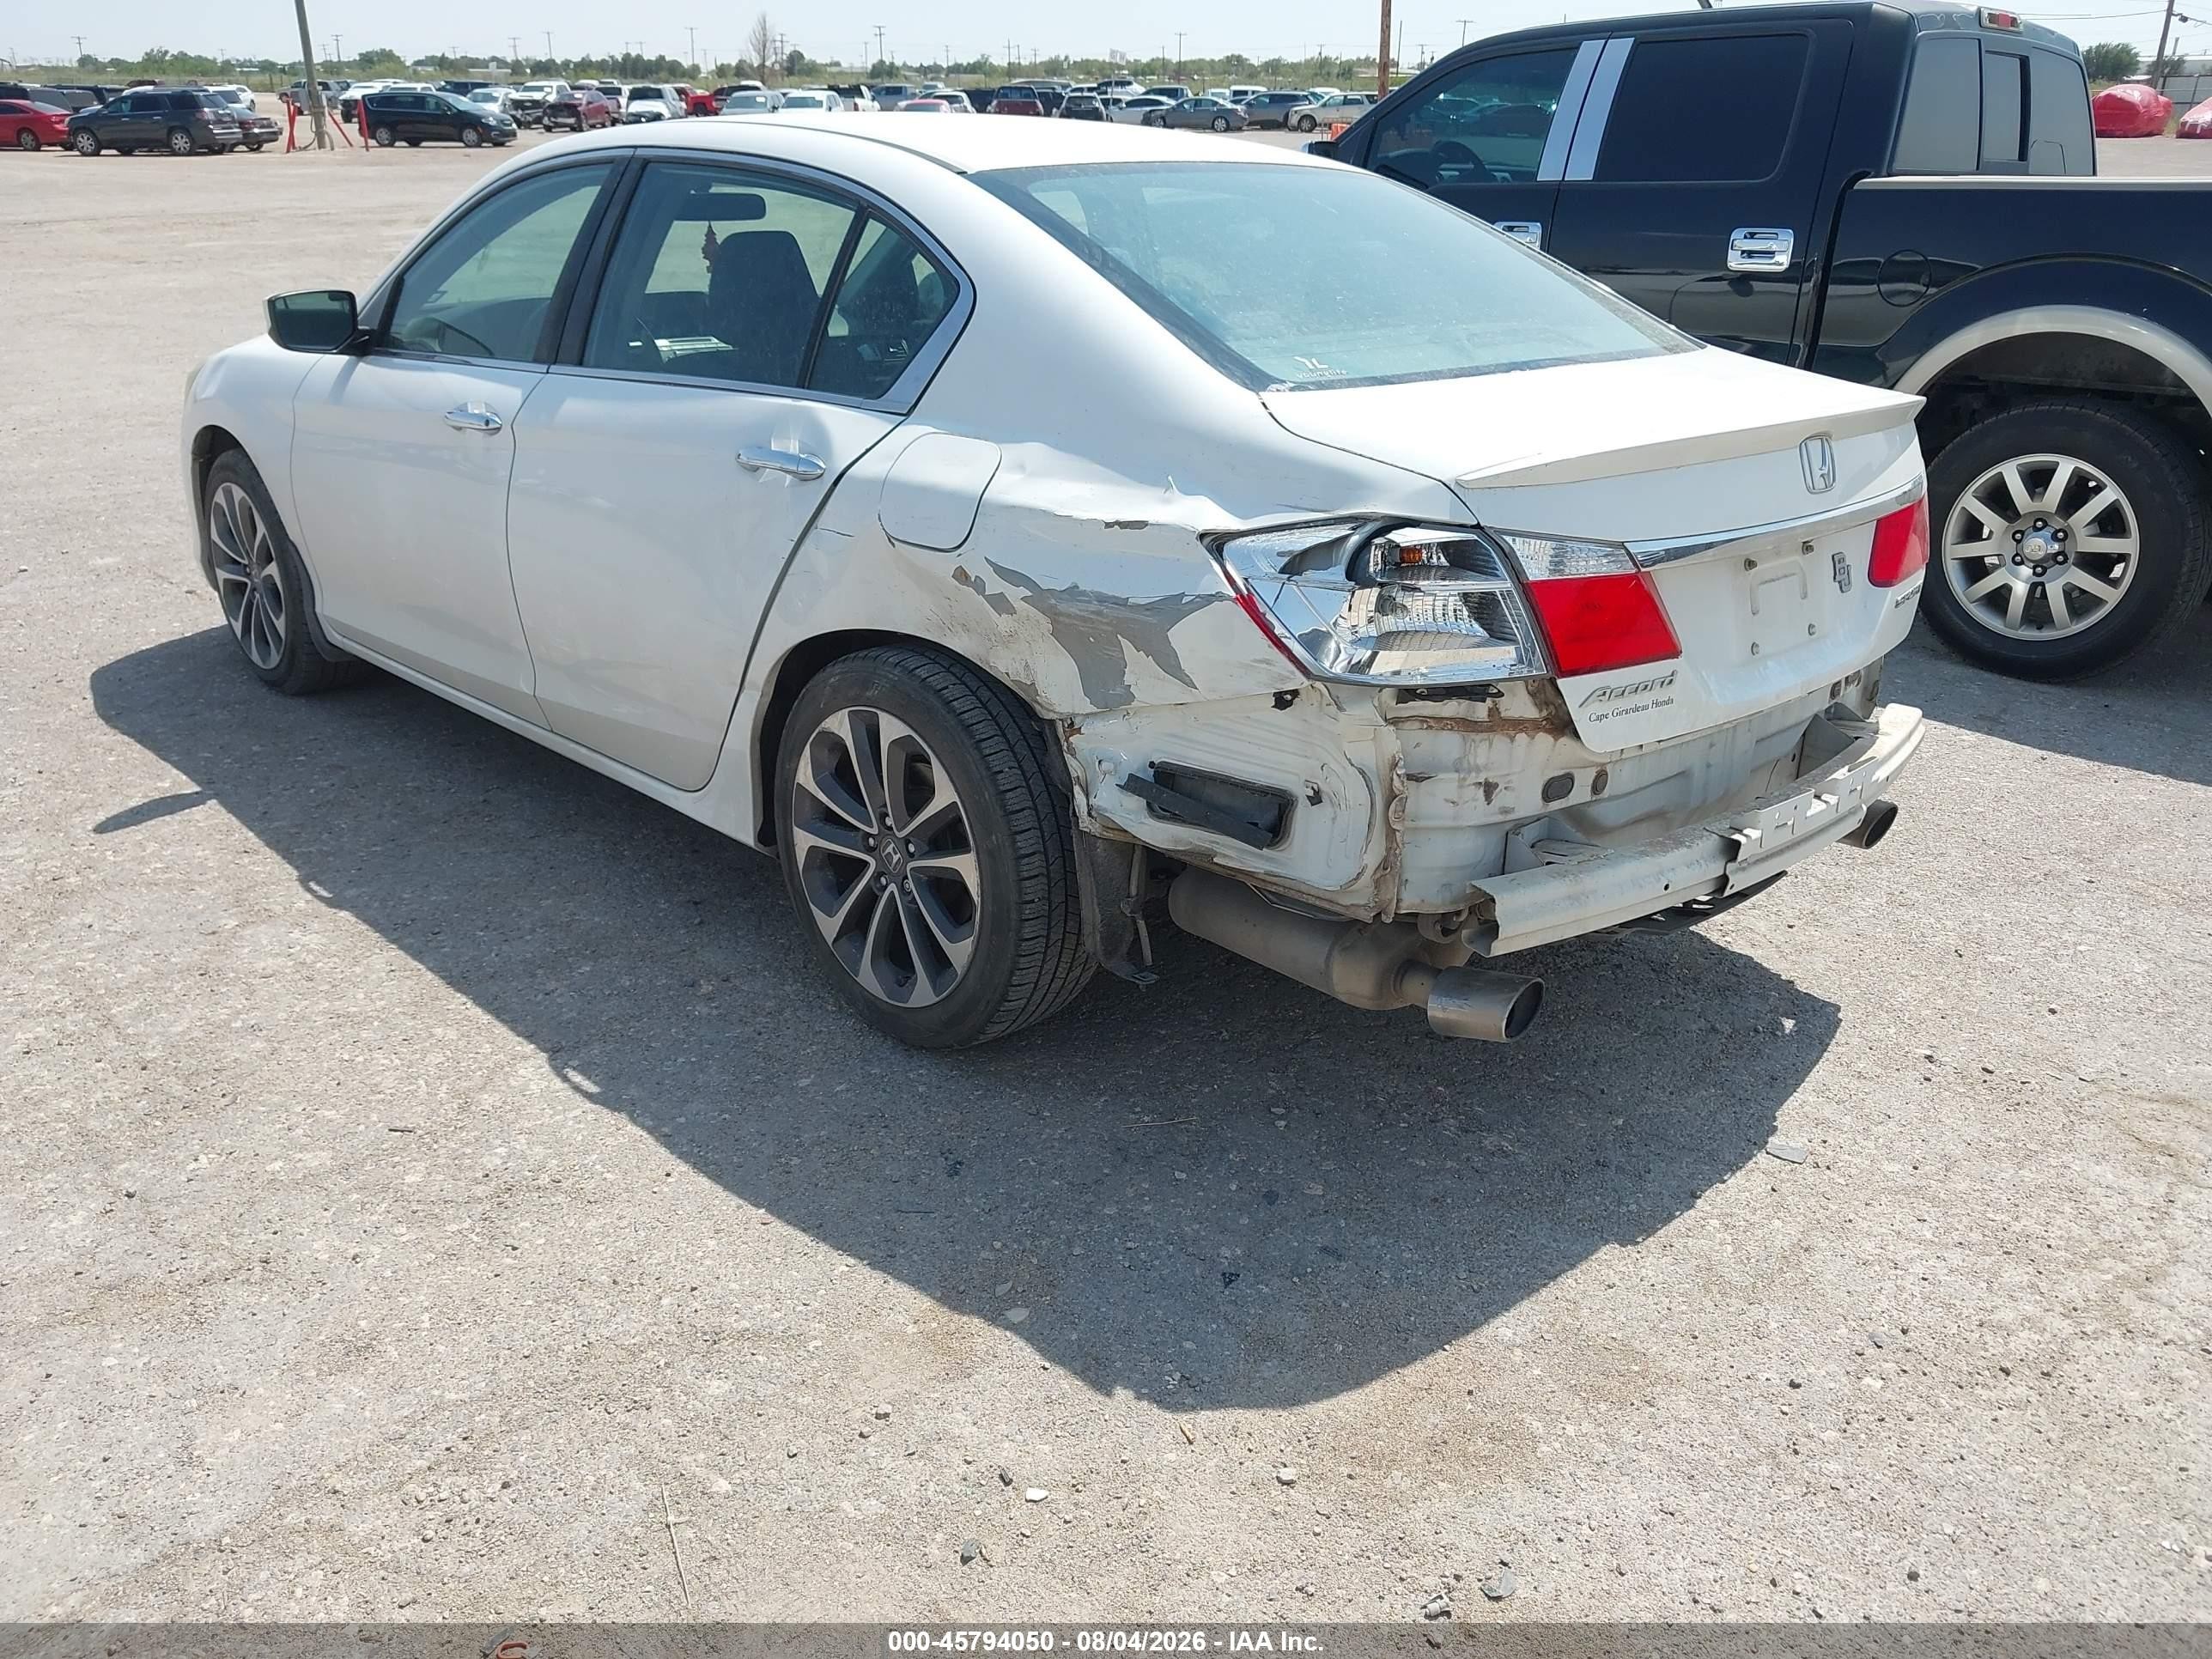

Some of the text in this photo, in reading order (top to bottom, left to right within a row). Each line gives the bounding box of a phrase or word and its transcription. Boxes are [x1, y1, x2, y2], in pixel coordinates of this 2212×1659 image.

[1578, 669, 1679, 708] Accord
[1588, 696, 1674, 723] Cape Girardeau Honda
